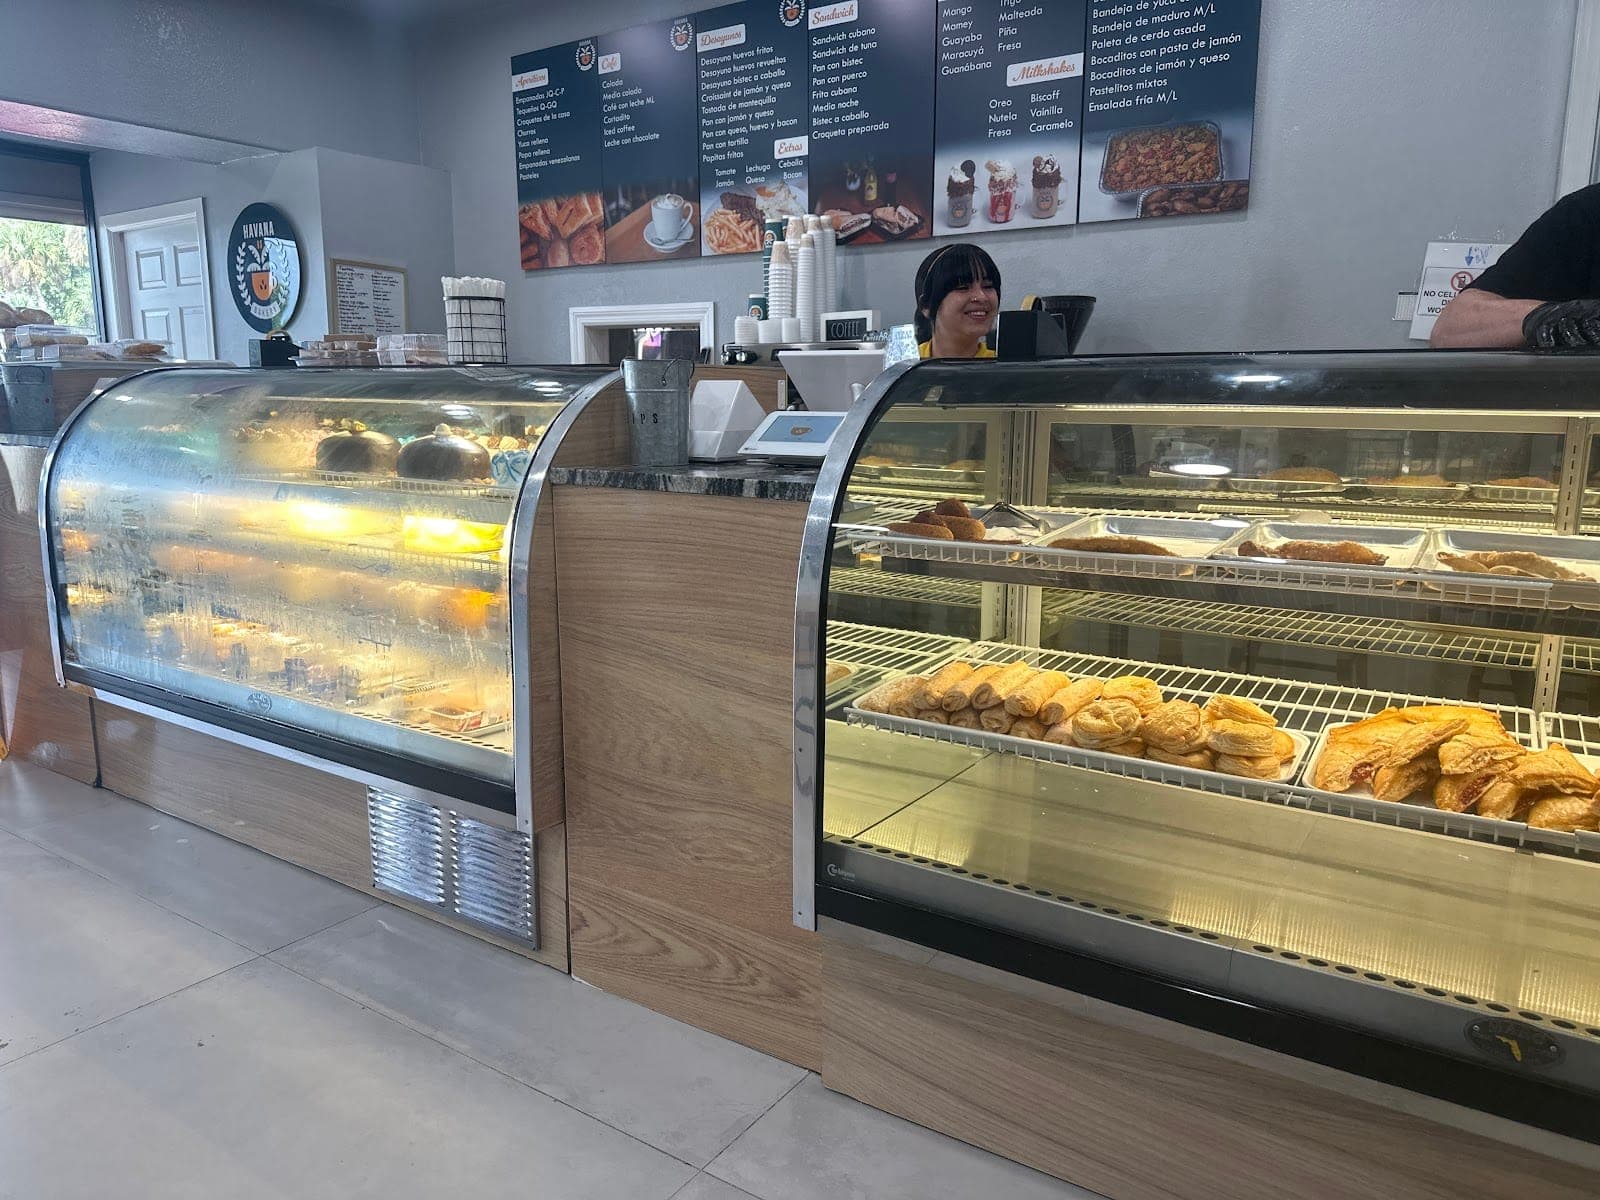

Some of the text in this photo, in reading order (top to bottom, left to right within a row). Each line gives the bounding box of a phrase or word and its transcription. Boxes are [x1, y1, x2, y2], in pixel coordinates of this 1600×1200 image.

[812, 4, 854, 24] Sandwich
[942, 6, 972, 18] Mango
[999, 6, 1043, 22] Malteada
[1093, 4, 1132, 19] Bandeja
[1136, 1, 1149, 11] de
[942, 20, 973, 32] Mamey
[1092, 3, 1216, 35] Bandeja de maduro M/L
[701, 31, 742, 46] Desayunos
[812, 28, 876, 46] Sandwich cubano
[998, 26, 1017, 37] Piña
[1092, 22, 1206, 50] Paleta de cerdo asada
[942, 33, 982, 46] Guayaba
[812, 42, 878, 60] Sandwich de tuna
[942, 46, 984, 62] Maracuyá
[998, 42, 1022, 52] Fresa
[1091, 33, 1242, 66] Bocaditos con pasta de jamón
[602, 56, 617, 70] Café
[701, 46, 774, 66] Desayuno huevos fritos
[701, 56, 787, 78] Desayuno huevos revueltos
[812, 64, 826, 72] Pan
[842, 58, 864, 68] bistec
[942, 61, 992, 76] Guanábana
[1012, 60, 1076, 82] Milkshakes
[1090, 52, 1230, 81] Bocaditos de jamón y queso
[602, 80, 623, 88] Colada
[702, 80, 732, 90] Desayuno
[734, 76, 752, 84] bistec
[760, 68, 786, 80] caballo
[812, 78, 826, 86] Pan
[842, 71, 868, 84] puerco
[603, 86, 642, 101] Media colada
[733, 89, 742, 97] de
[744, 86, 763, 97] jamón
[772, 82, 792, 92] queso
[812, 86, 858, 100] Frita cubana
[1090, 77, 1168, 96] Pastelitos mixtos
[516, 93, 544, 104] Empanadas
[989, 99, 1012, 108] Oreo
[1030, 90, 1060, 103] Biscoff
[1088, 90, 1178, 112] Ensalada fría M/L
[603, 102, 617, 112] Café
[630, 98, 644, 108] leche
[702, 96, 776, 114] Tostada de mantequilla
[812, 98, 859, 112] Media noche
[1030, 106, 1063, 118] Vainilla
[516, 117, 542, 126] Croquetas
[604, 114, 630, 124] Cortadito
[728, 112, 746, 124] jamón
[754, 110, 774, 119] queso
[812, 117, 832, 126] Bistec
[842, 110, 870, 122] caballo
[988, 112, 1018, 124] Nutela
[617, 124, 635, 133] coffee
[702, 130, 714, 138] Pan
[728, 126, 748, 136] queso,
[750, 123, 768, 132] huevo
[777, 118, 798, 128] bacon
[812, 121, 890, 140] Croqueta preparada
[1030, 119, 1074, 132] Caramelo
[517, 129, 536, 137] Churros
[604, 138, 620, 148] Leche
[632, 132, 660, 142] chocolate
[988, 128, 1012, 138] Fresa
[702, 142, 714, 150] Pan
[728, 137, 748, 146] tortilla
[778, 142, 802, 154] Extras
[703, 150, 744, 162] Papitas fritas
[778, 158, 803, 168] Cebolla
[520, 160, 548, 170] Empanadas
[715, 168, 736, 176] Tomate
[746, 164, 770, 172] Lechuga
[520, 172, 540, 180] Pasteles
[746, 176, 766, 184] Queso
[716, 179, 734, 188] Jamón
[242, 220, 274, 238] HAVANA
[831, 321, 860, 338] COFFEE
